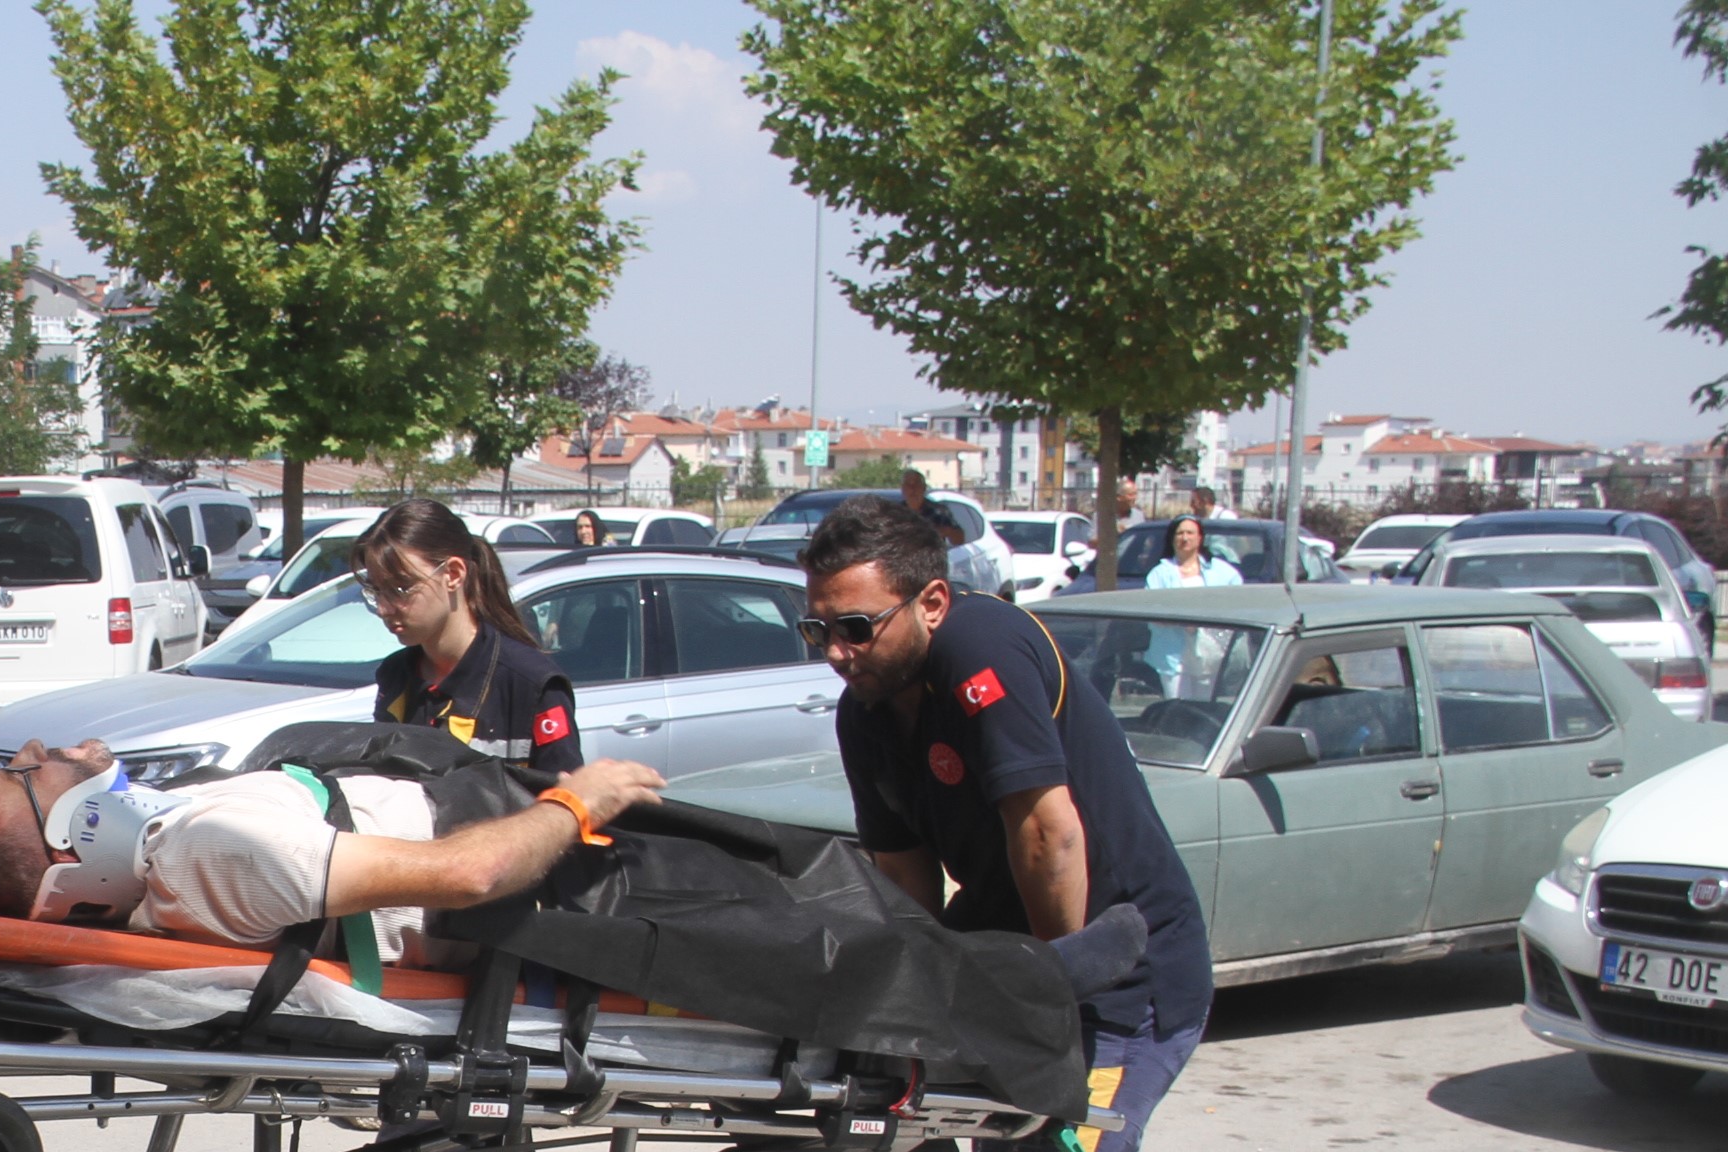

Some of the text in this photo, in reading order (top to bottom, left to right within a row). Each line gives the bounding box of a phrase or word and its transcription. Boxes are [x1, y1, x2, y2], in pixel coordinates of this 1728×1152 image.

[21, 626, 45, 639] 010
[1618, 951, 1649, 984] 42
[1669, 957, 1722, 994] DOE
[472, 1104, 505, 1116] PULL
[853, 1122, 881, 1132] PULL
